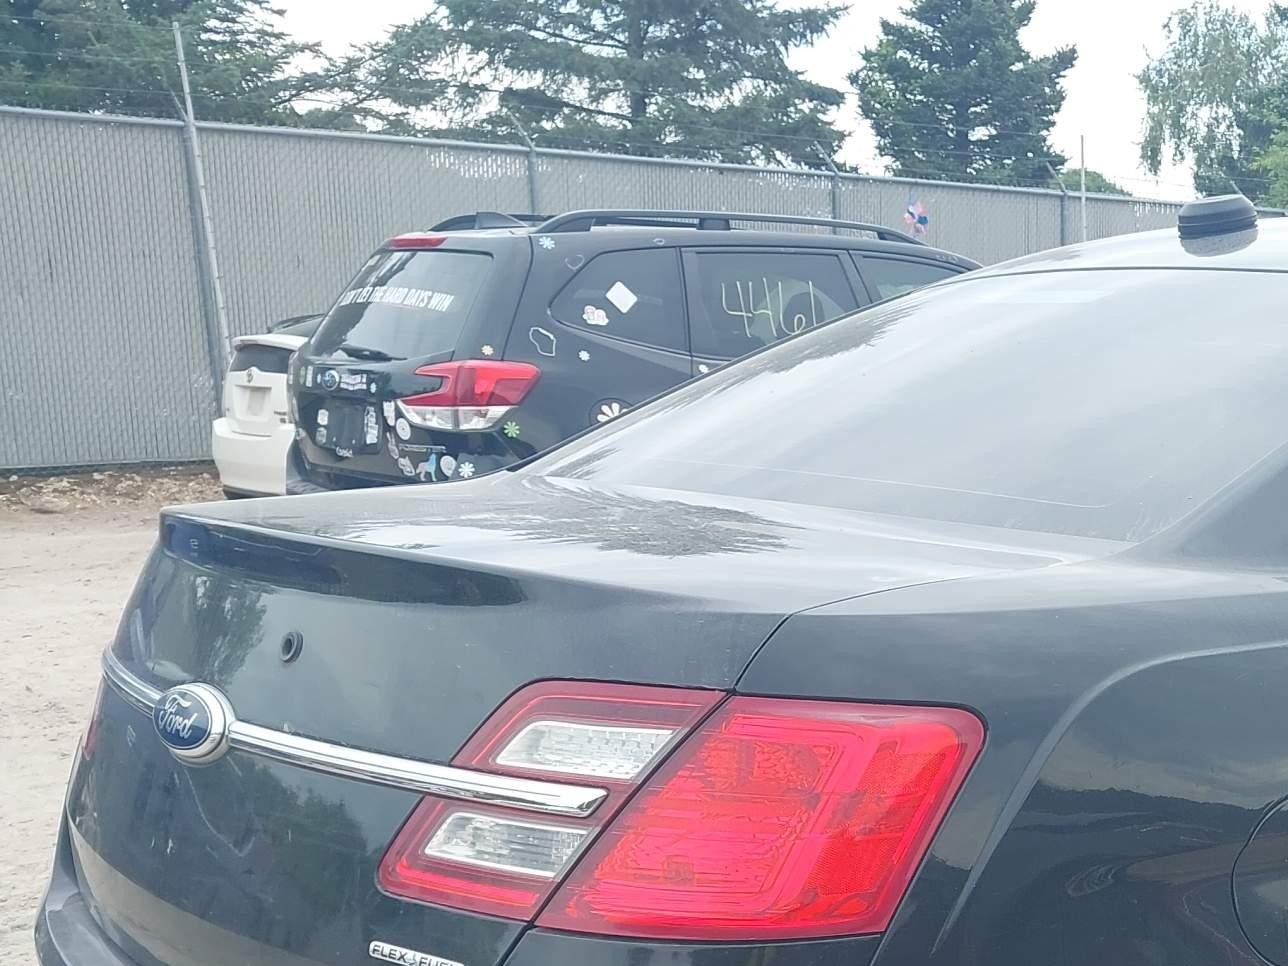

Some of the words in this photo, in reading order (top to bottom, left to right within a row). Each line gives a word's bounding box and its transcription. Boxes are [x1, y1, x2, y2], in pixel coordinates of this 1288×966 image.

[403, 288, 433, 308] DAYS
[427, 292, 455, 312] WIN
[721, 277, 817, 338] 4461
[158, 694, 198, 739] Ford
[371, 944, 408, 963] FLEX
